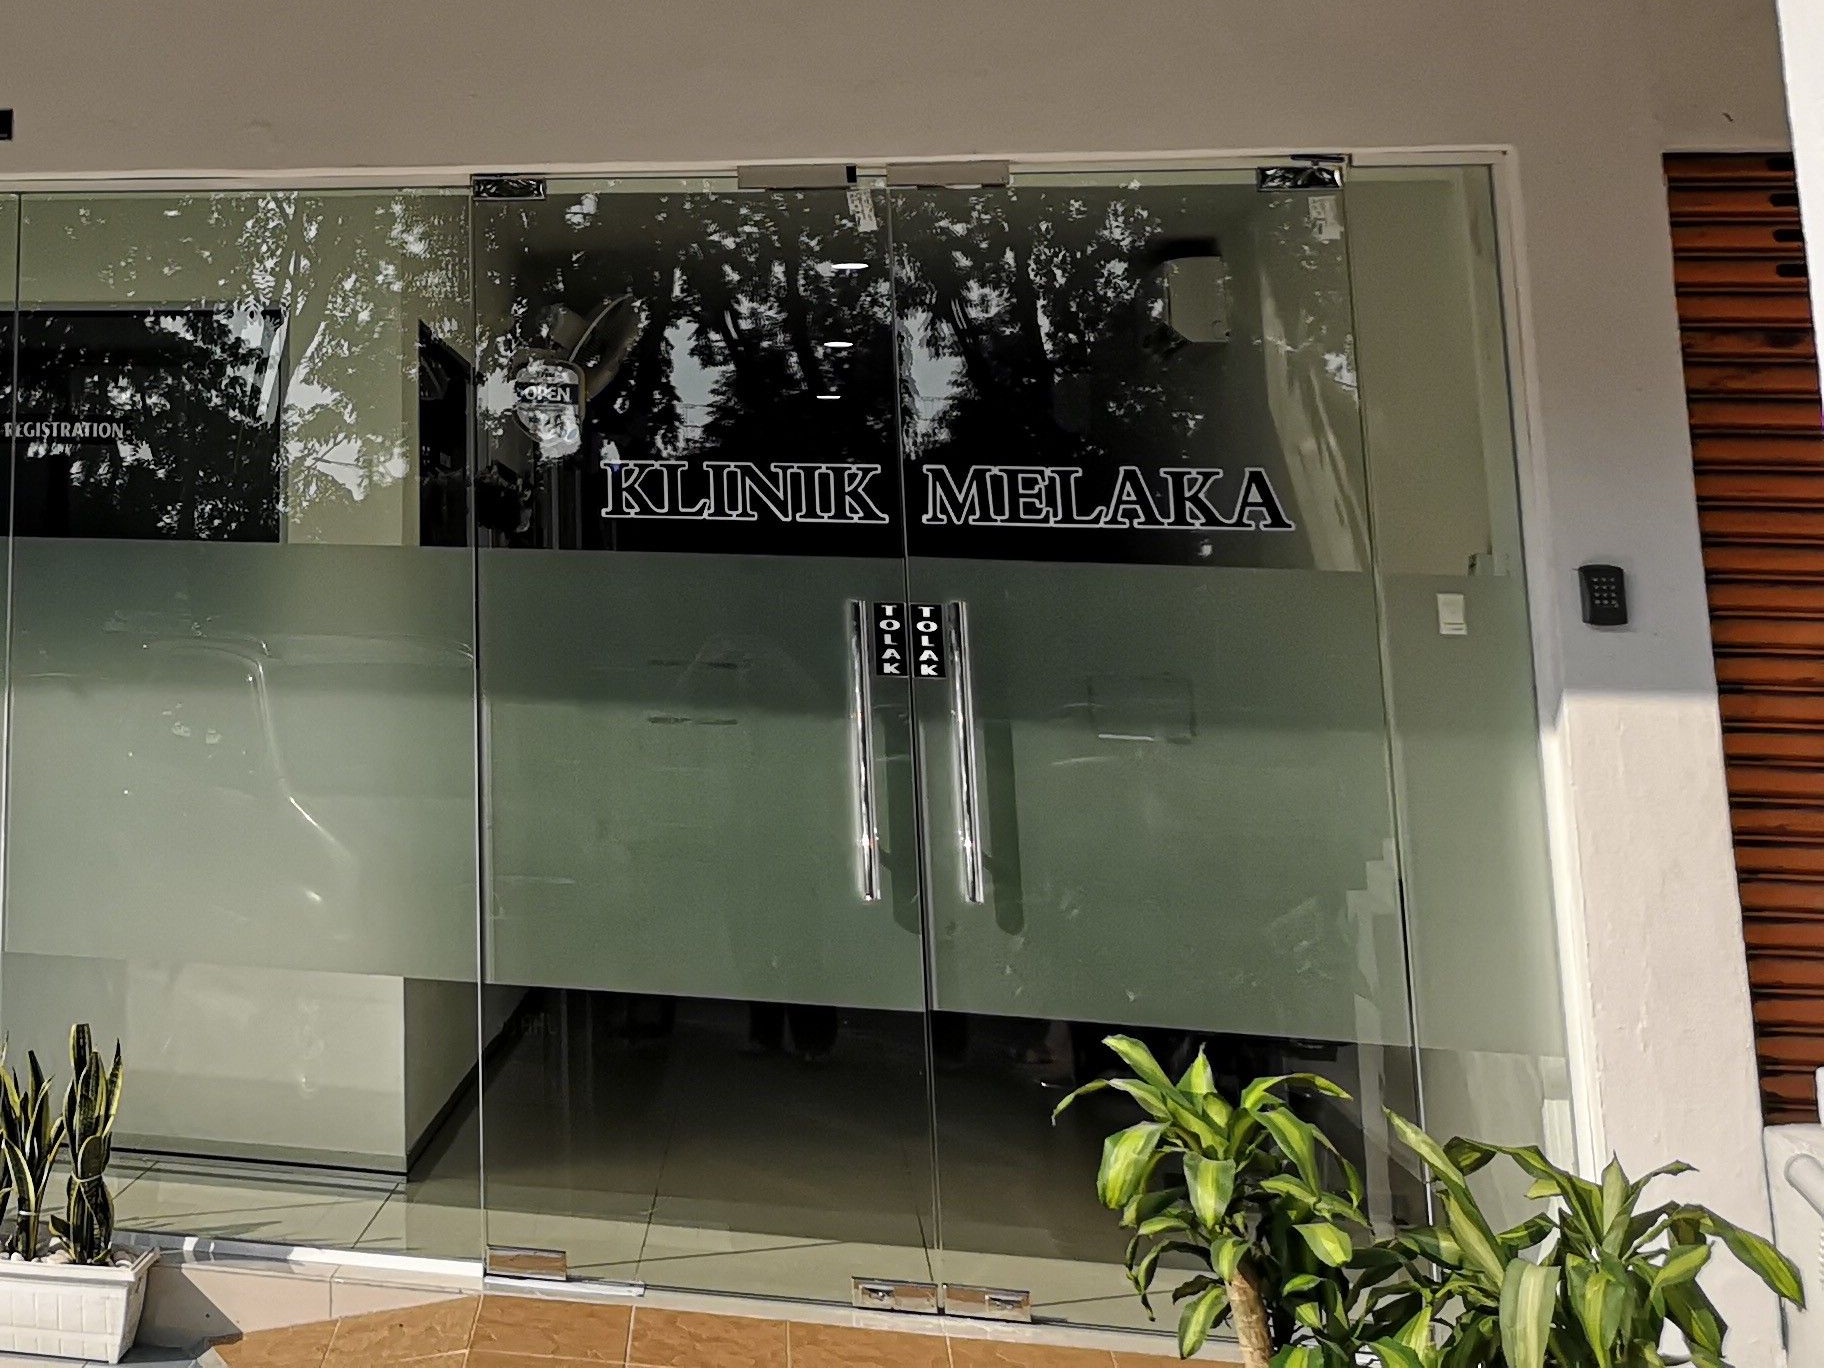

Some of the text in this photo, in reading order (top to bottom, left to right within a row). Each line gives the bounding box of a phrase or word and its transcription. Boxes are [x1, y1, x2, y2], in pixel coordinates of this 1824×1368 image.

[524, 385, 571, 402] OPEN
[4, 421, 124, 439] REGISTRATION
[600, 460, 1296, 531] KLINIK MELAKA
[879, 604, 901, 674] TOLAK
[916, 606, 939, 676] TOLAK
